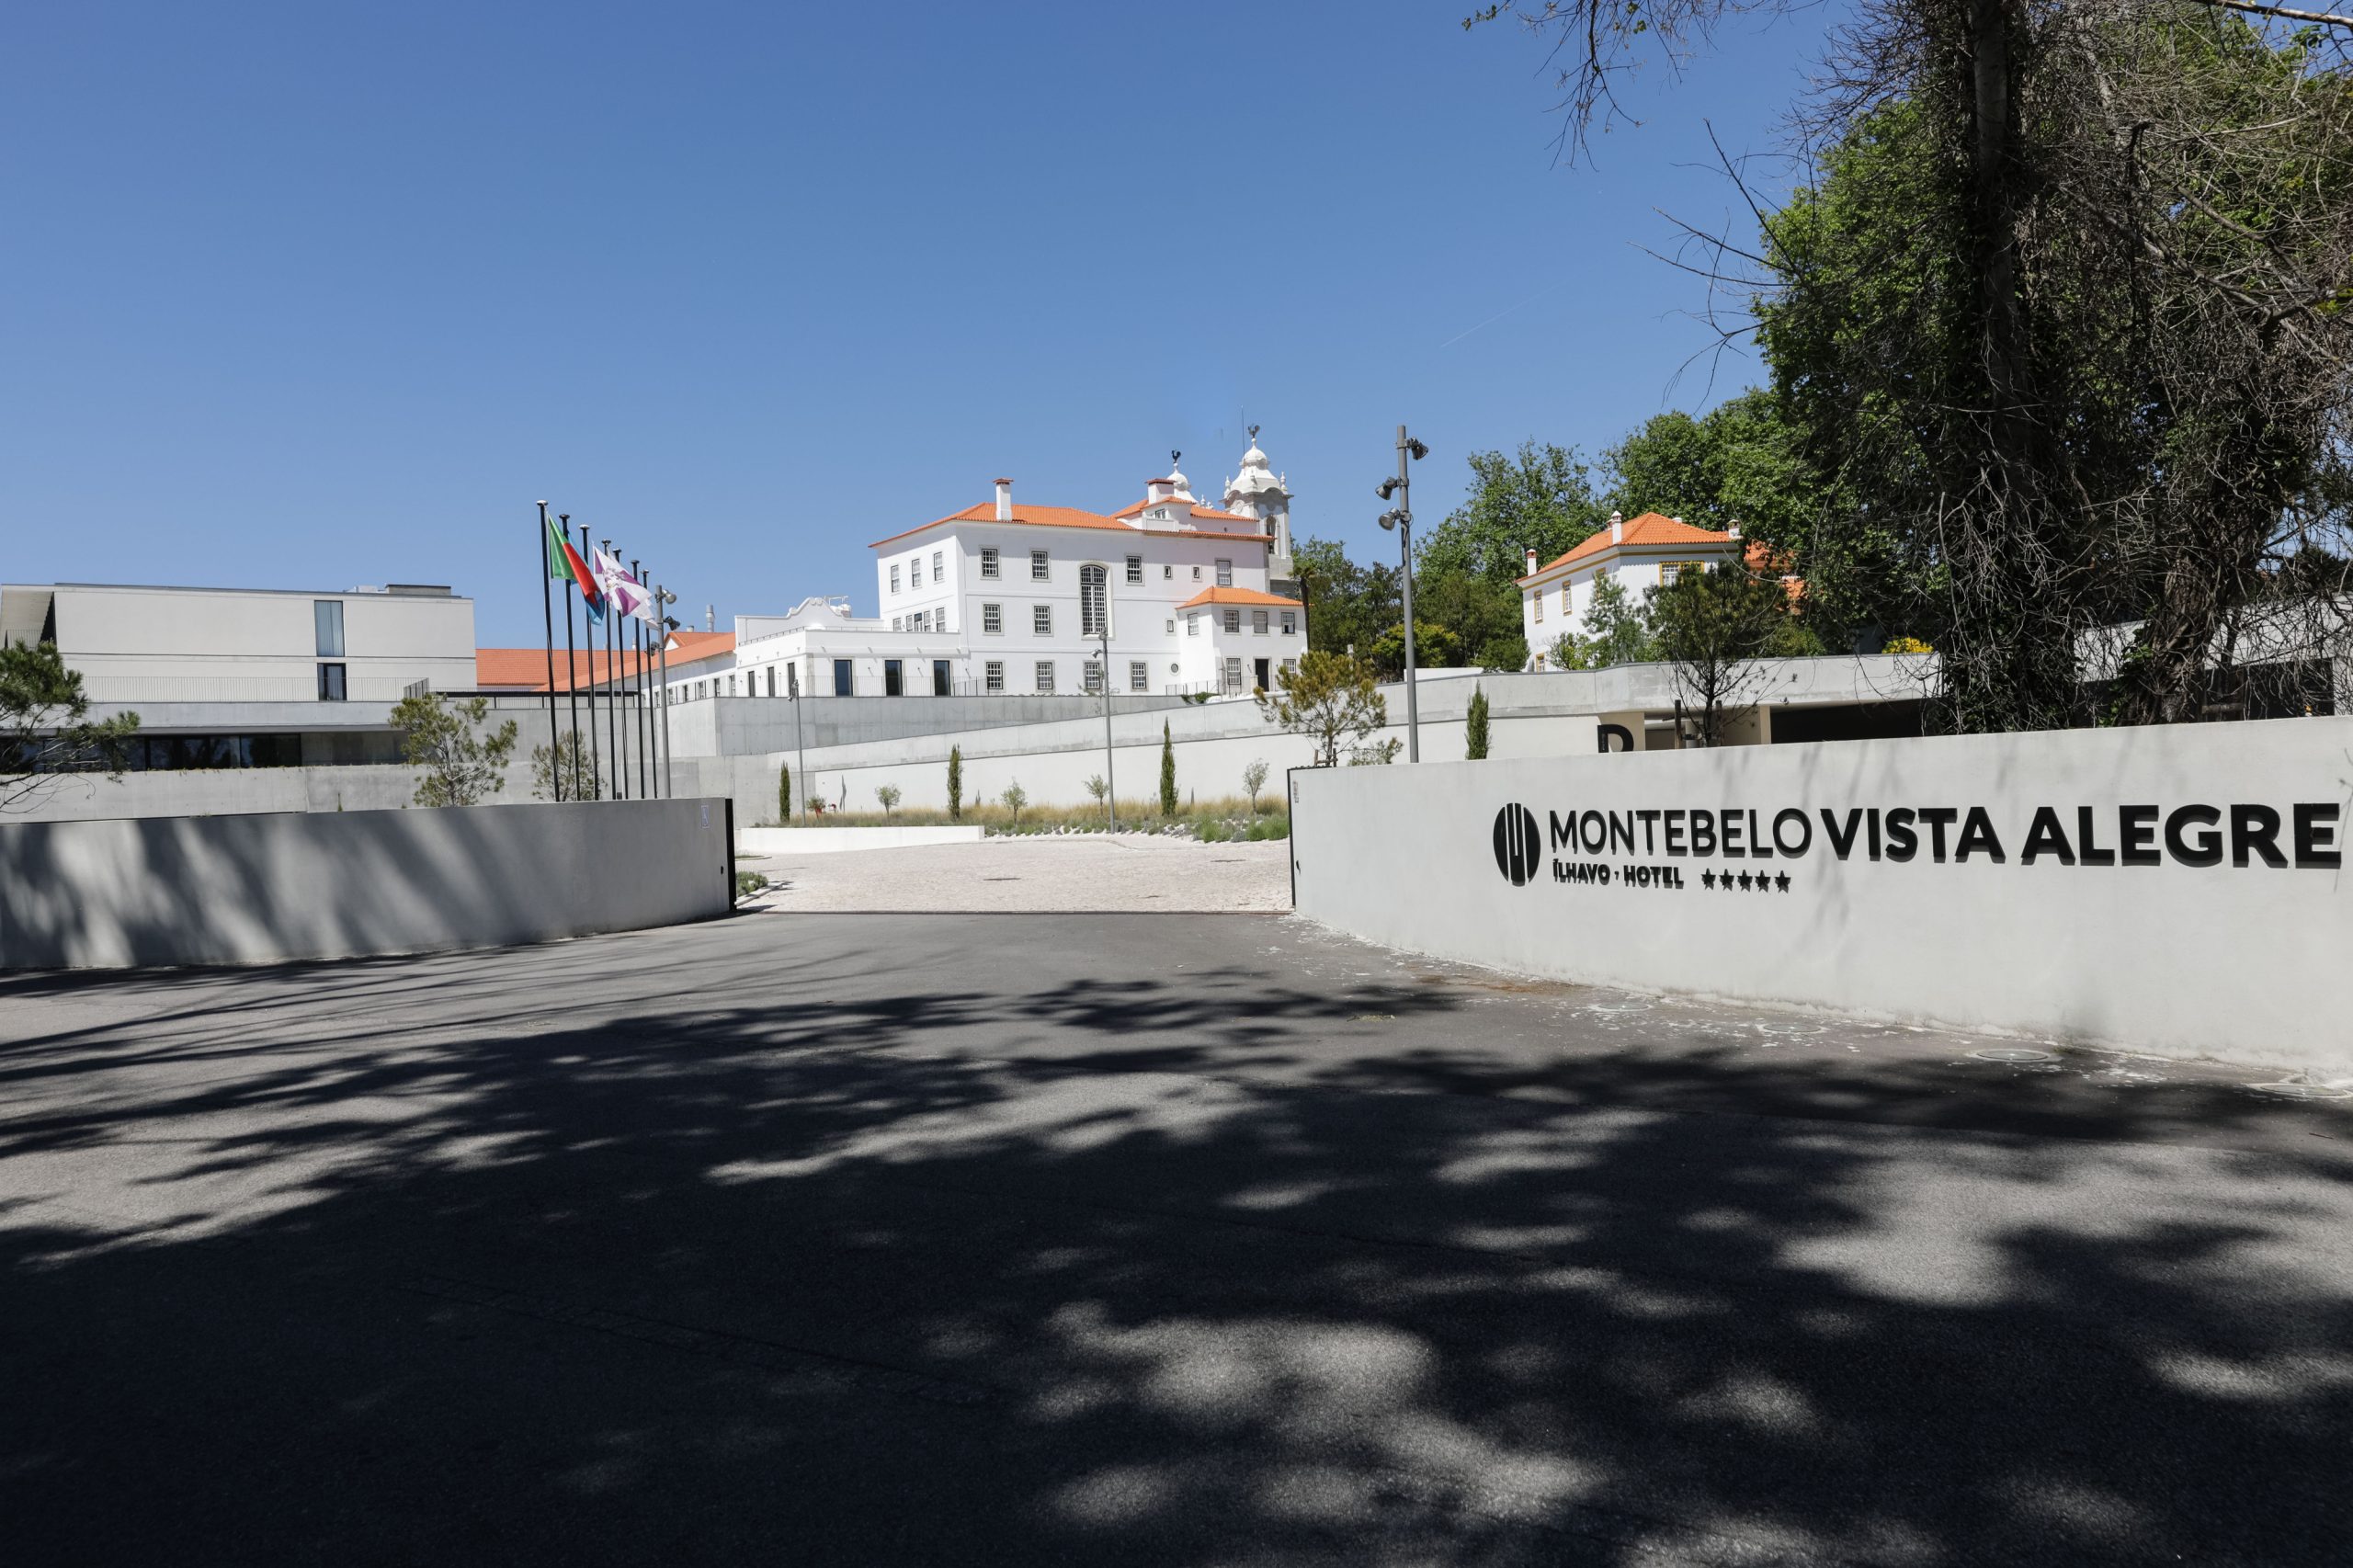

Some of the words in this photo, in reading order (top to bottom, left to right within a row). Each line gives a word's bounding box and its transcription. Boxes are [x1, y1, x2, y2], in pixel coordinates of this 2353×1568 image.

[1550, 808, 1813, 858] MONTEBELO
[1820, 807, 2006, 864] VISTA
[2020, 803, 2342, 869] ALEGRE
[1623, 865, 1684, 889] HOTEL
